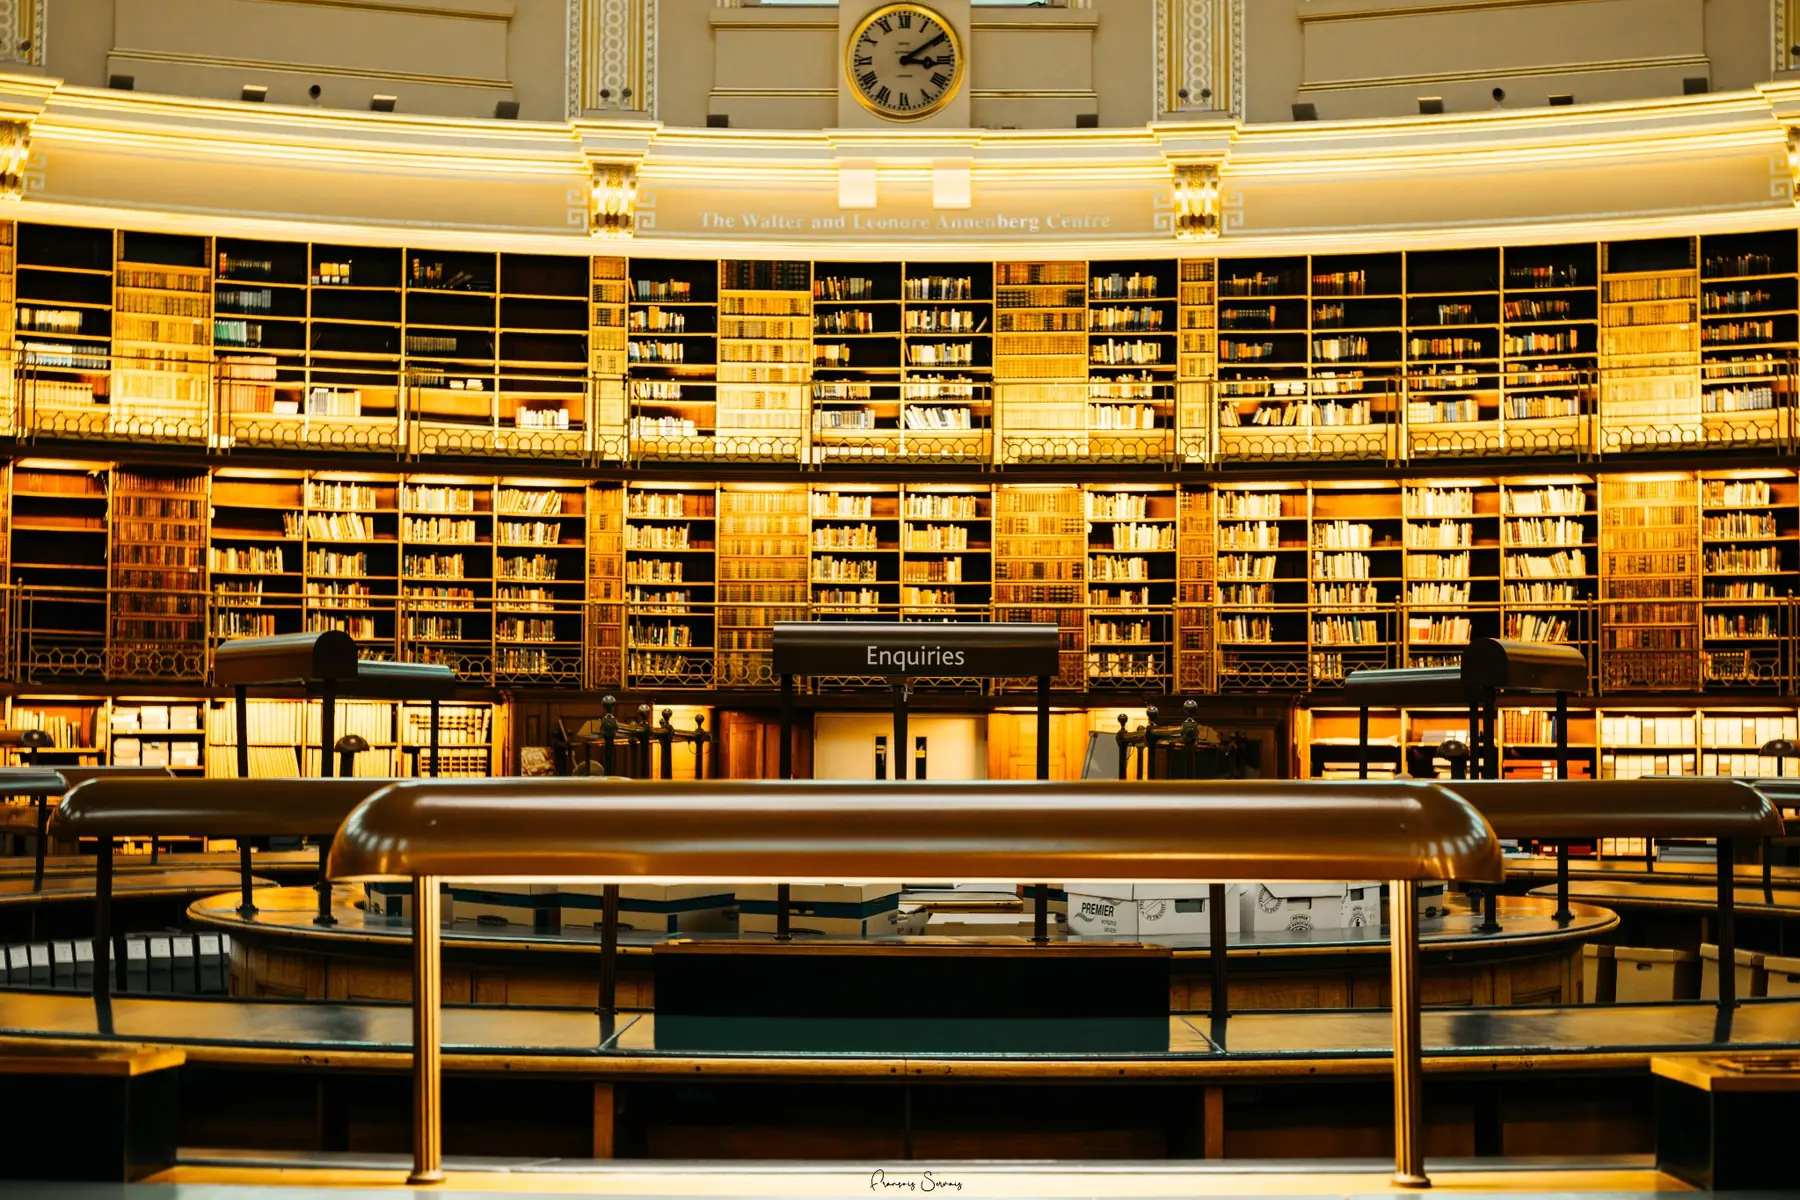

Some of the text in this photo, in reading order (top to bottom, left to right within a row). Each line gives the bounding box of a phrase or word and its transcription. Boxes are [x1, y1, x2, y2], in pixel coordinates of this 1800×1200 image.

[700, 211, 1111, 232] The Walter and Leonore Annenberg Centre
[866, 645, 965, 672] Enquiries
[1081, 902, 1115, 918] PREMIER
